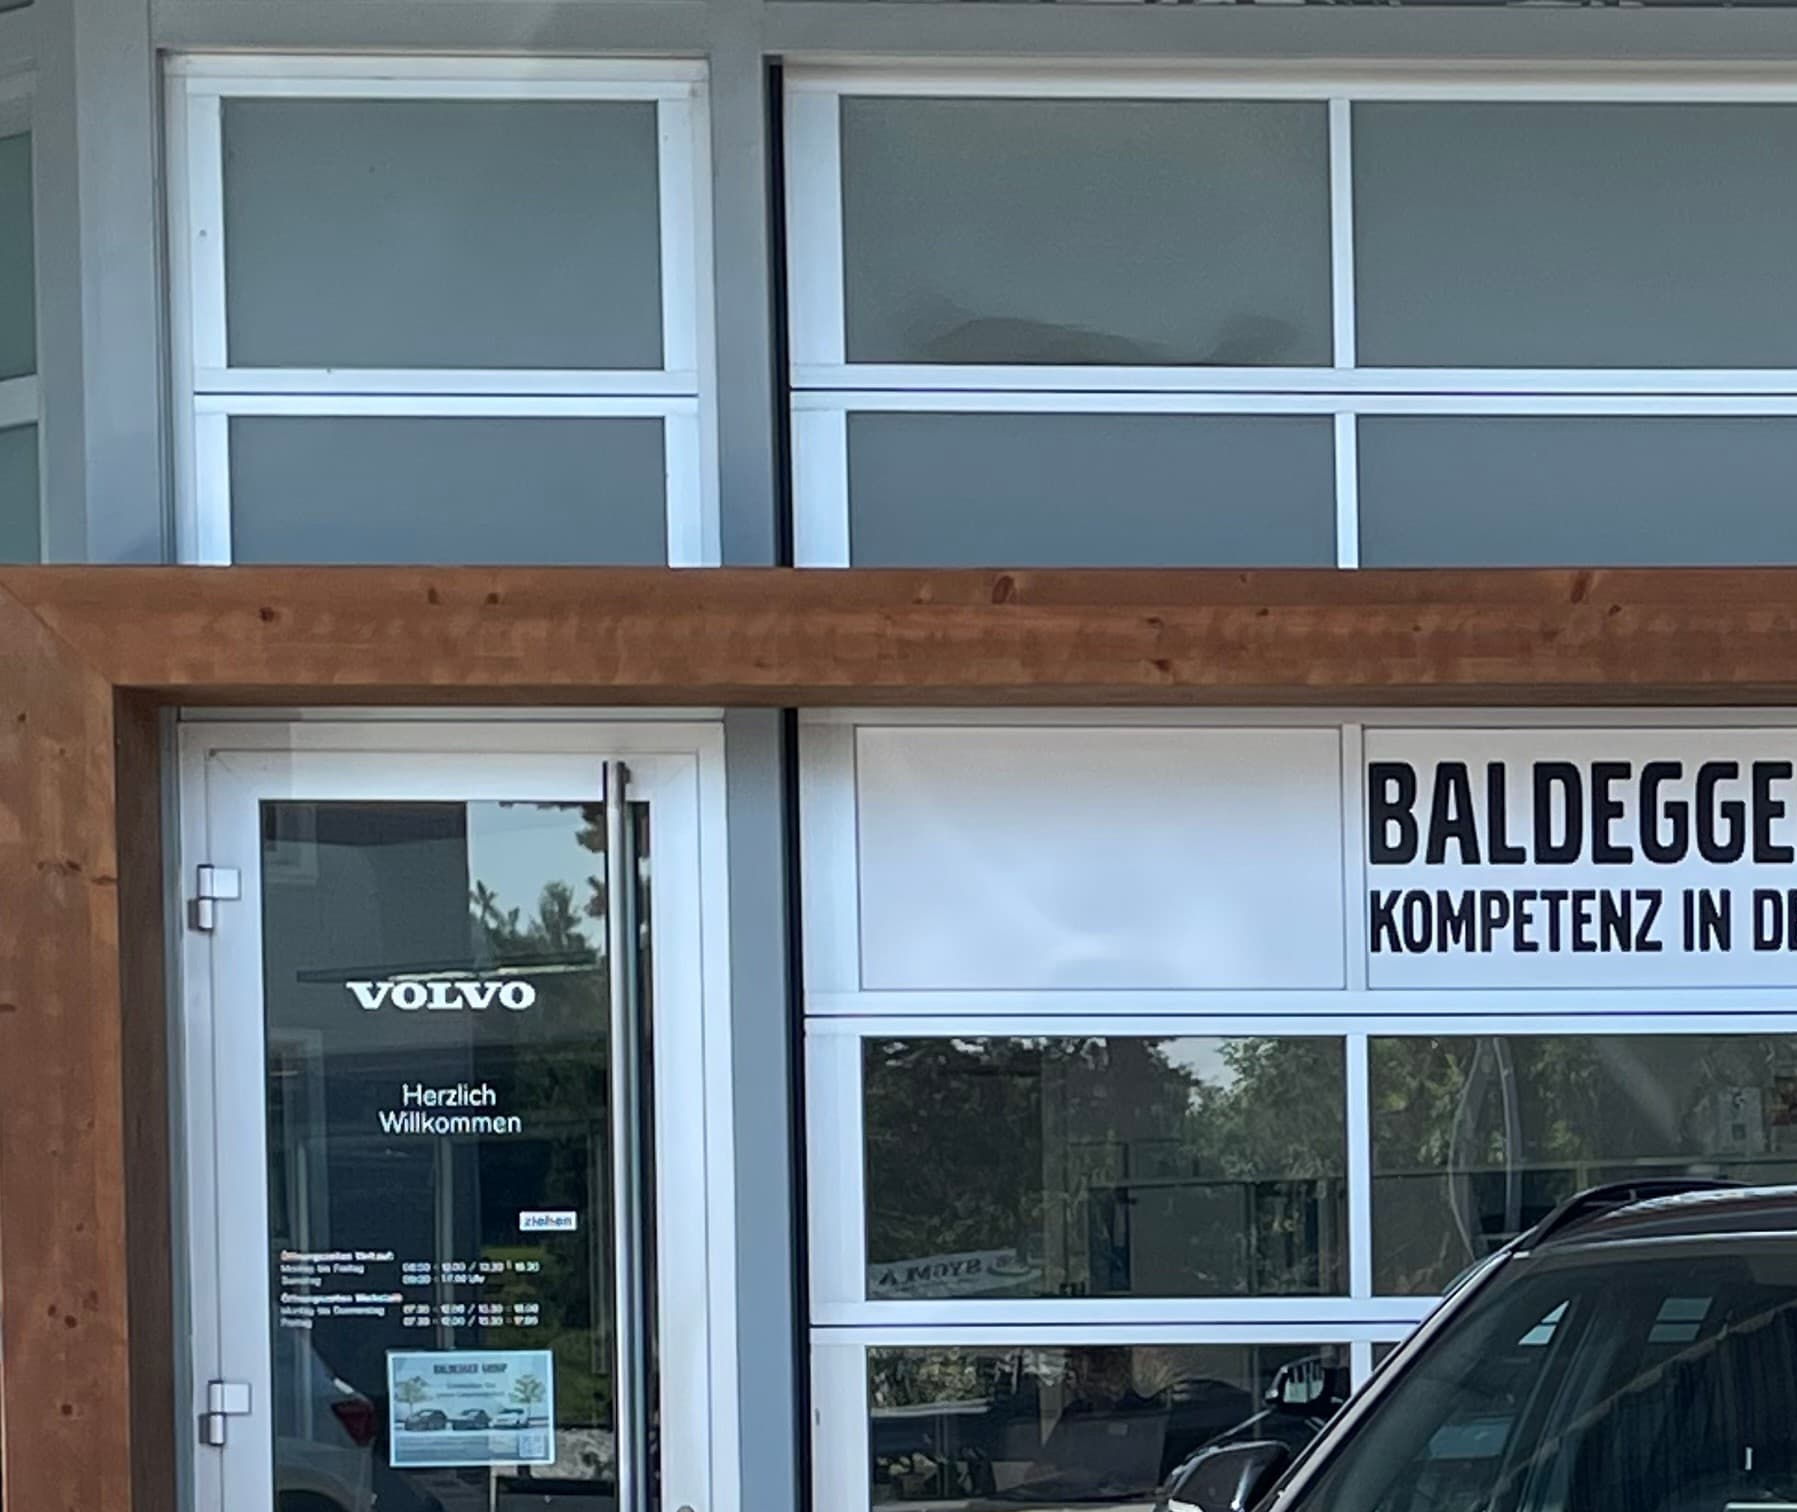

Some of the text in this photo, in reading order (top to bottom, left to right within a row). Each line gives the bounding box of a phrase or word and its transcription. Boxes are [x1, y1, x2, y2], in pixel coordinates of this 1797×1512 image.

[1369, 888, 1663, 953] KOMPETENZ
[1683, 888, 1731, 952] IN
[346, 981, 536, 1010] VOLVO
[402, 1083, 497, 1107] Herzlich
[378, 1111, 522, 1135] Willkommen
[524, 1214, 572, 1227] ziehen
